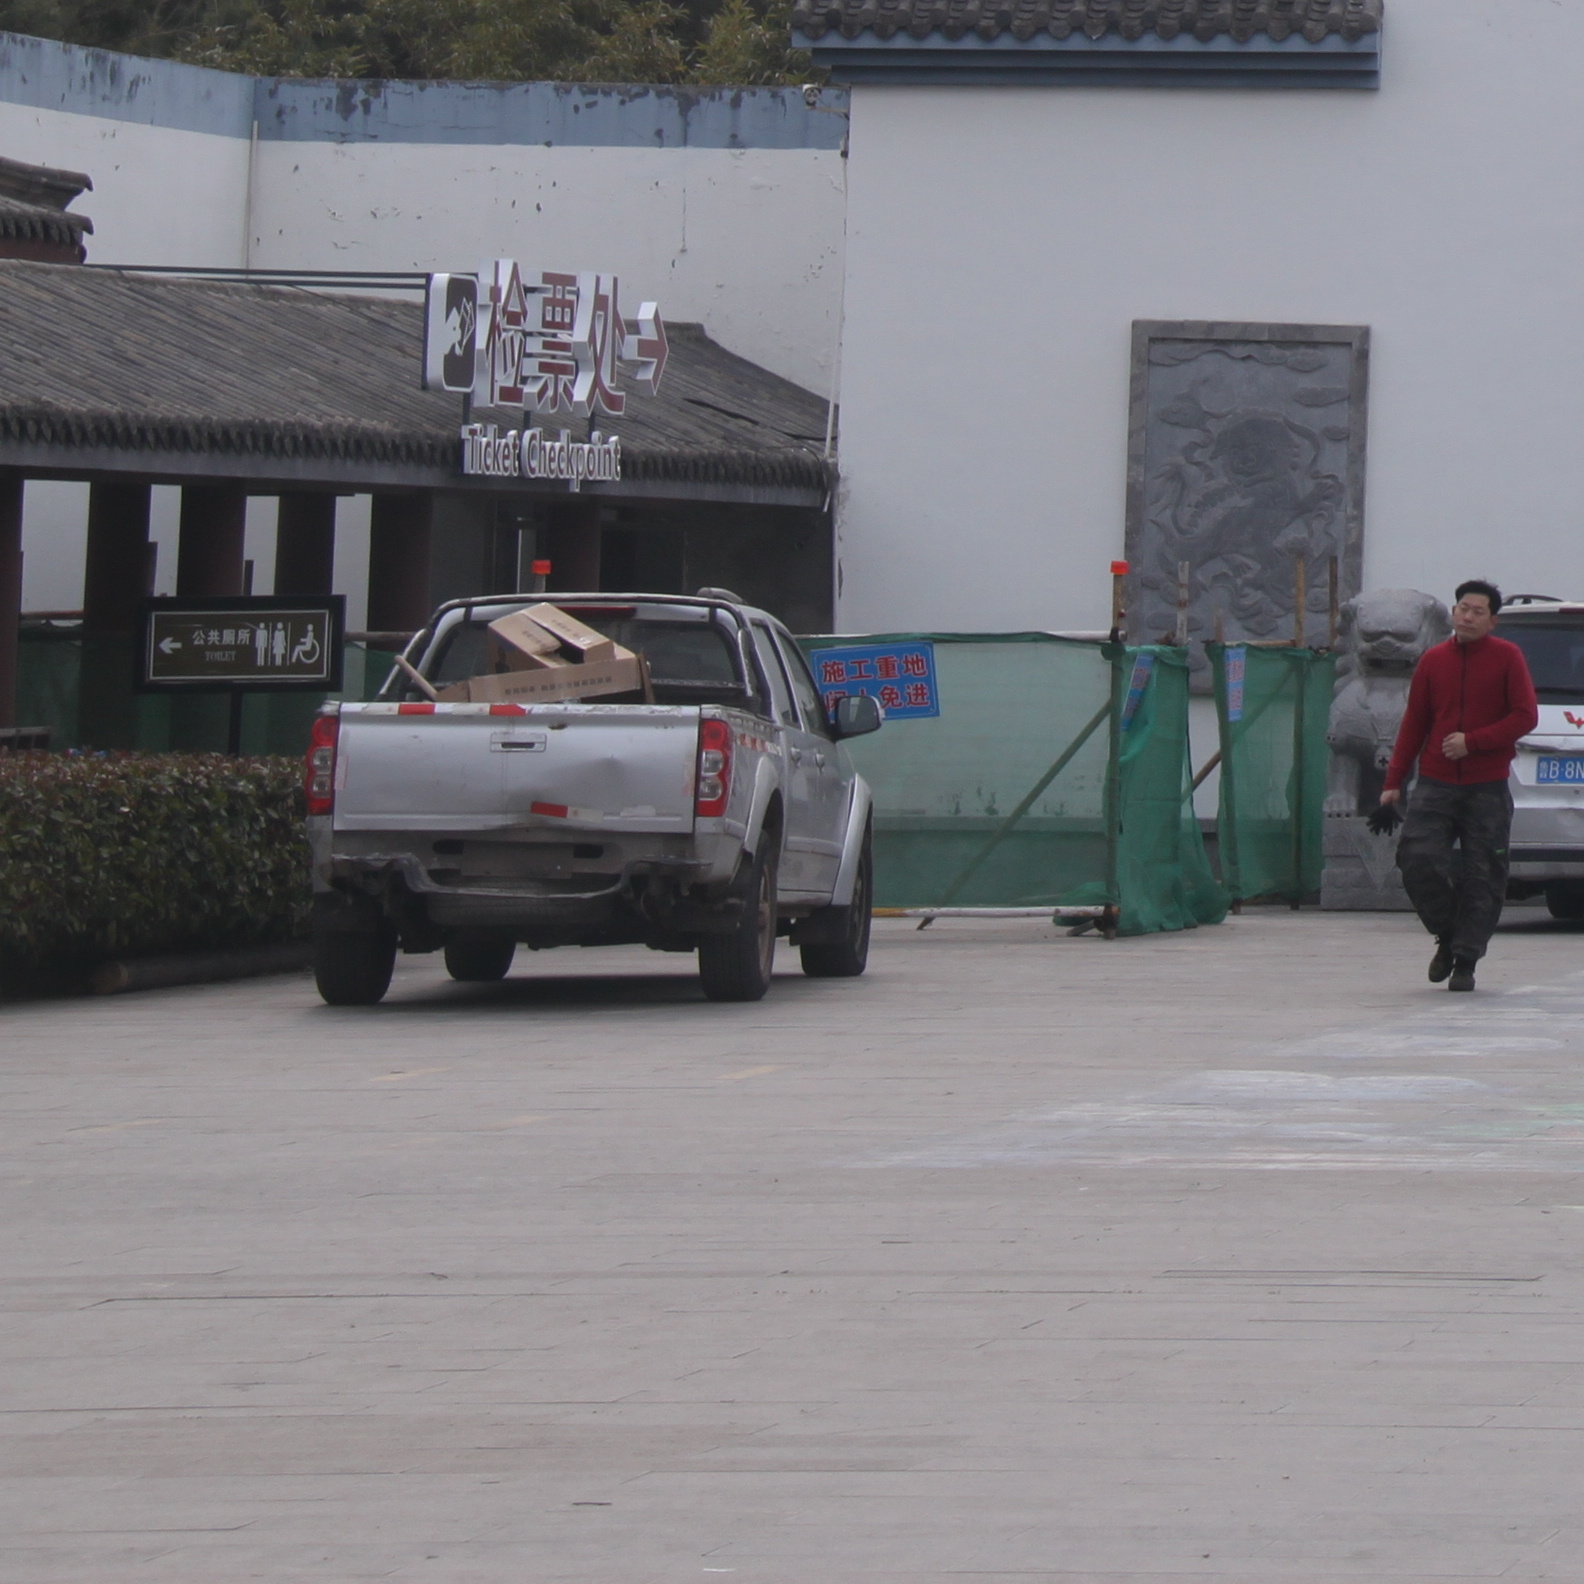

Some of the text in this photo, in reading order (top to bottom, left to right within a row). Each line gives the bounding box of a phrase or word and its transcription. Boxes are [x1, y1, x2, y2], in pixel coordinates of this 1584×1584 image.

[478, 259, 626, 415] 检票处
[462, 424, 622, 493] Ticket Checkpoint
[192, 628, 251, 646] 公共厕所
[205, 650, 236, 661] TOILET
[821, 653, 927, 685] 施工重地
